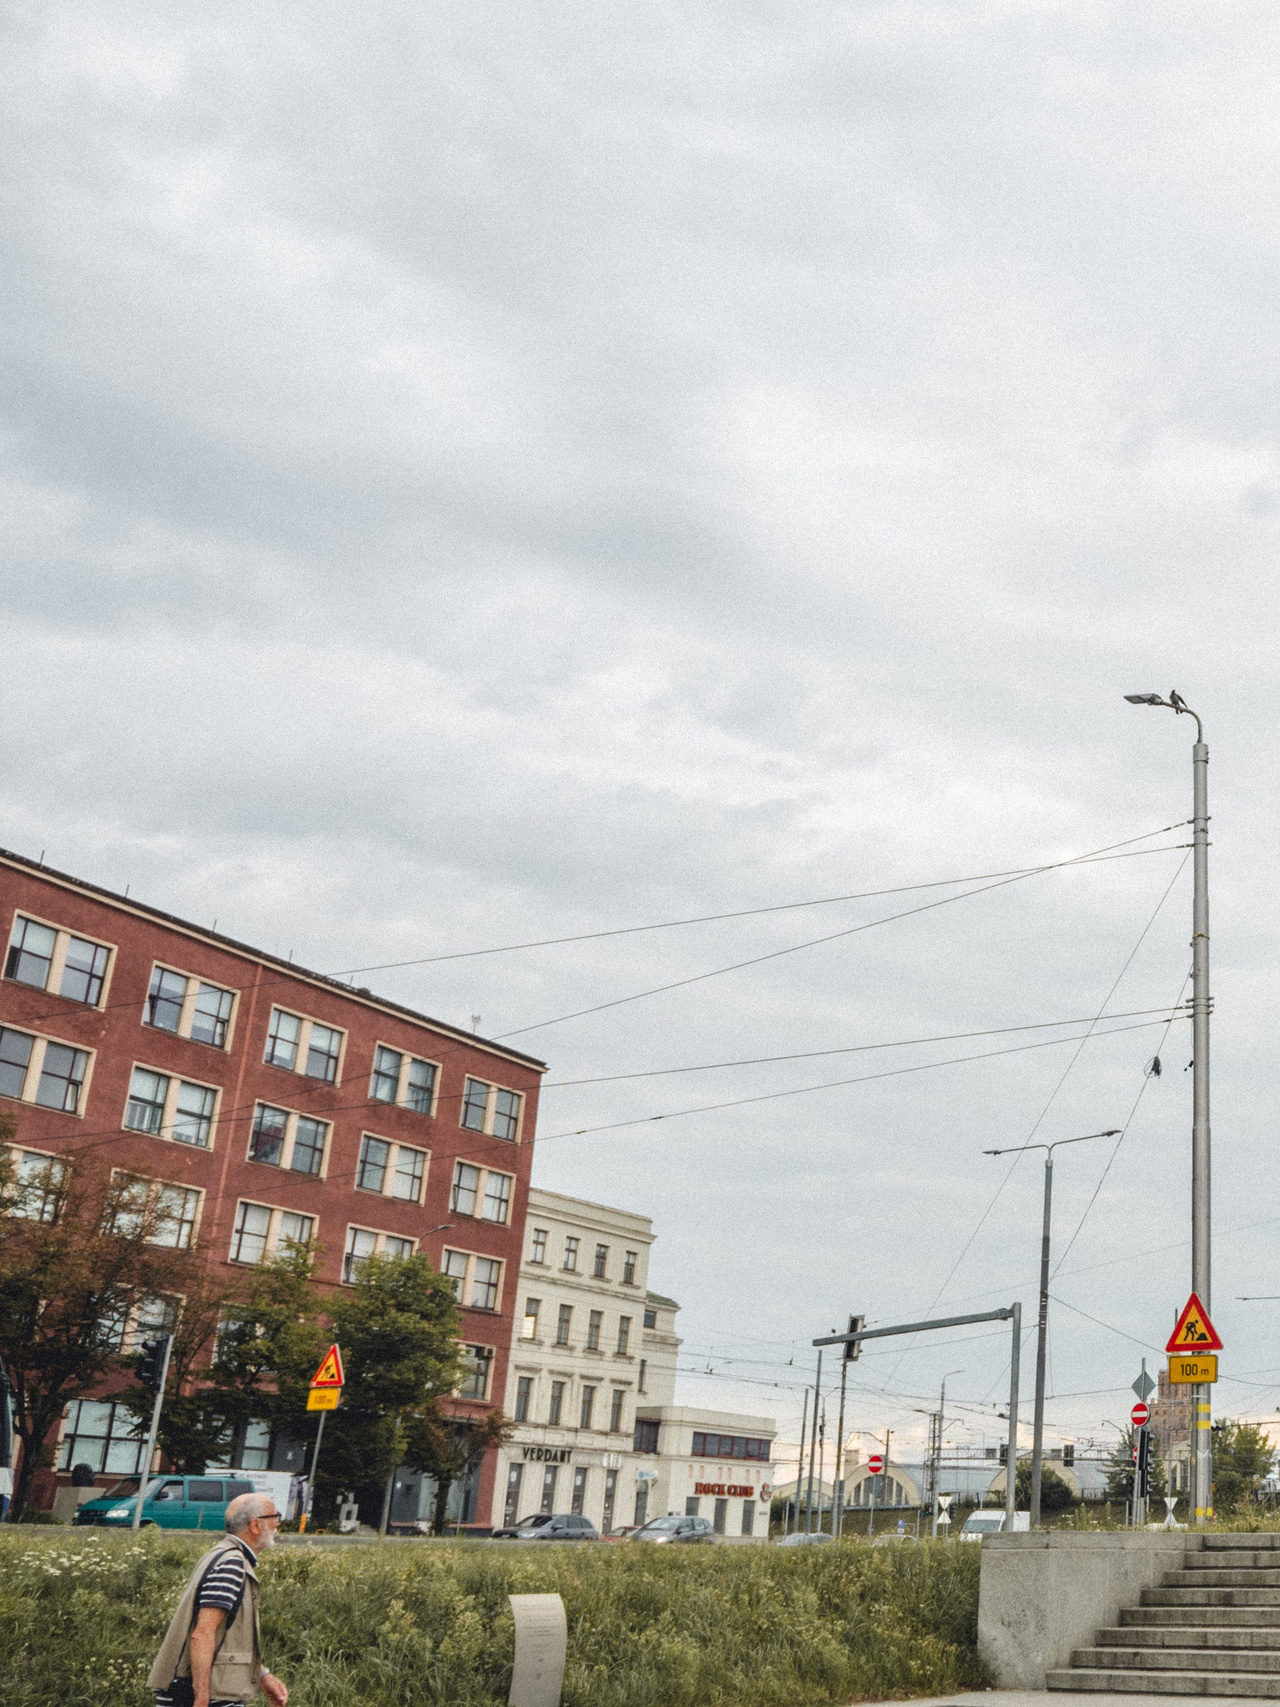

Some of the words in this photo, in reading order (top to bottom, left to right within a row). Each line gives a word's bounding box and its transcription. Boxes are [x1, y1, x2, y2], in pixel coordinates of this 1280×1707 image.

[1181, 1363, 1198, 1376] 100
[522, 1446, 572, 1464] VERDANT
[694, 1482, 726, 1496] ROCK
[727, 1484, 755, 1497] CLUB
